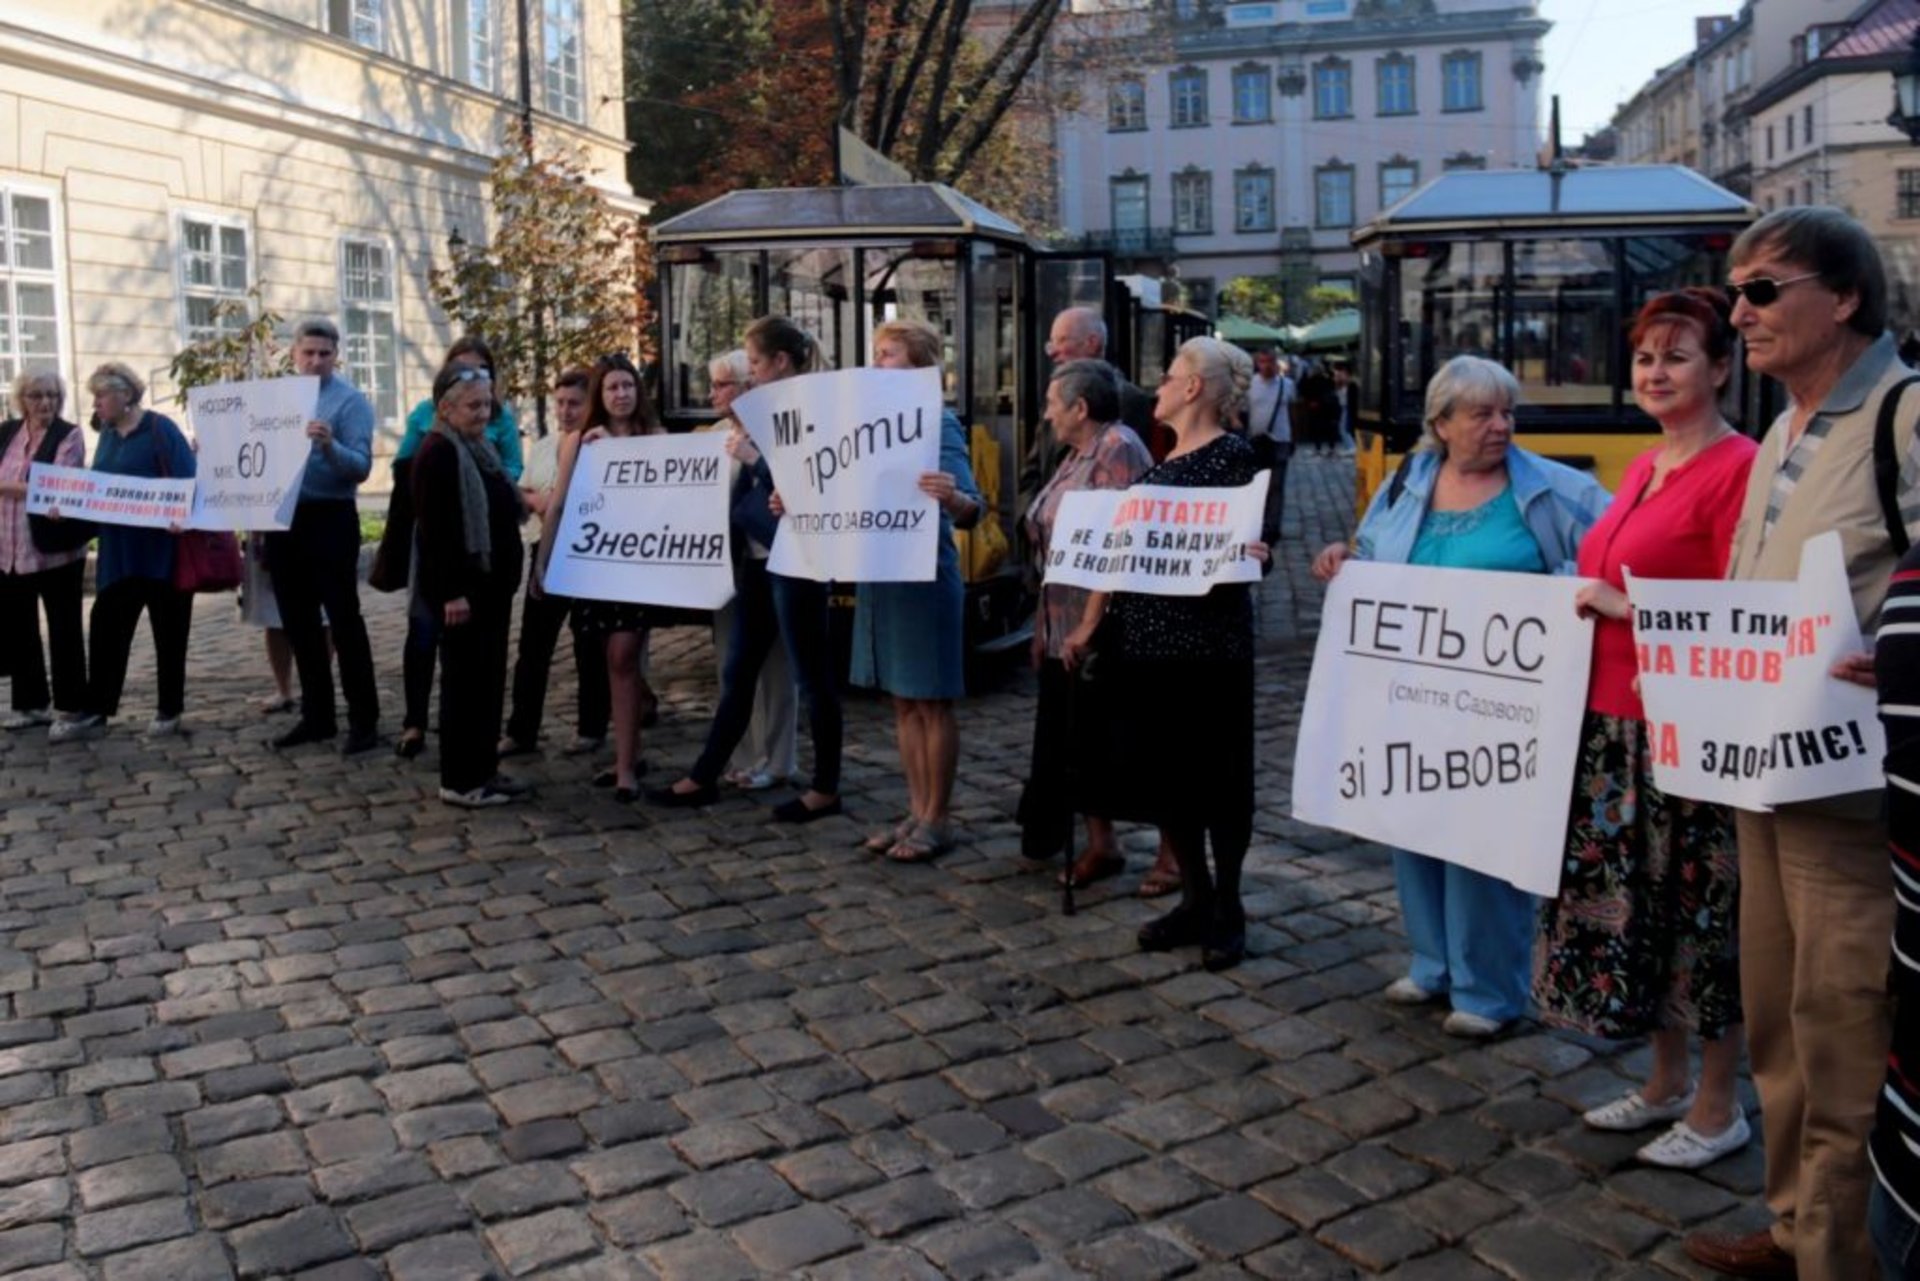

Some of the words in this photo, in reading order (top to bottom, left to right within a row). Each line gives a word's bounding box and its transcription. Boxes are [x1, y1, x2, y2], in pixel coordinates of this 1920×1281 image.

[238, 442, 266, 479] 60
[603, 460, 658, 484] ГЕТЬ
[664, 456, 720, 482] РУКИ
[572, 521, 725, 560] Знесіння
[1070, 528, 1094, 545] НЕ
[1349, 598, 1467, 661] ГЕТЬ
[1483, 614, 1547, 672] СС
[1631, 604, 1711, 632] ракт
[1339, 747, 1366, 800] зі
[1382, 737, 1538, 796] Львова
